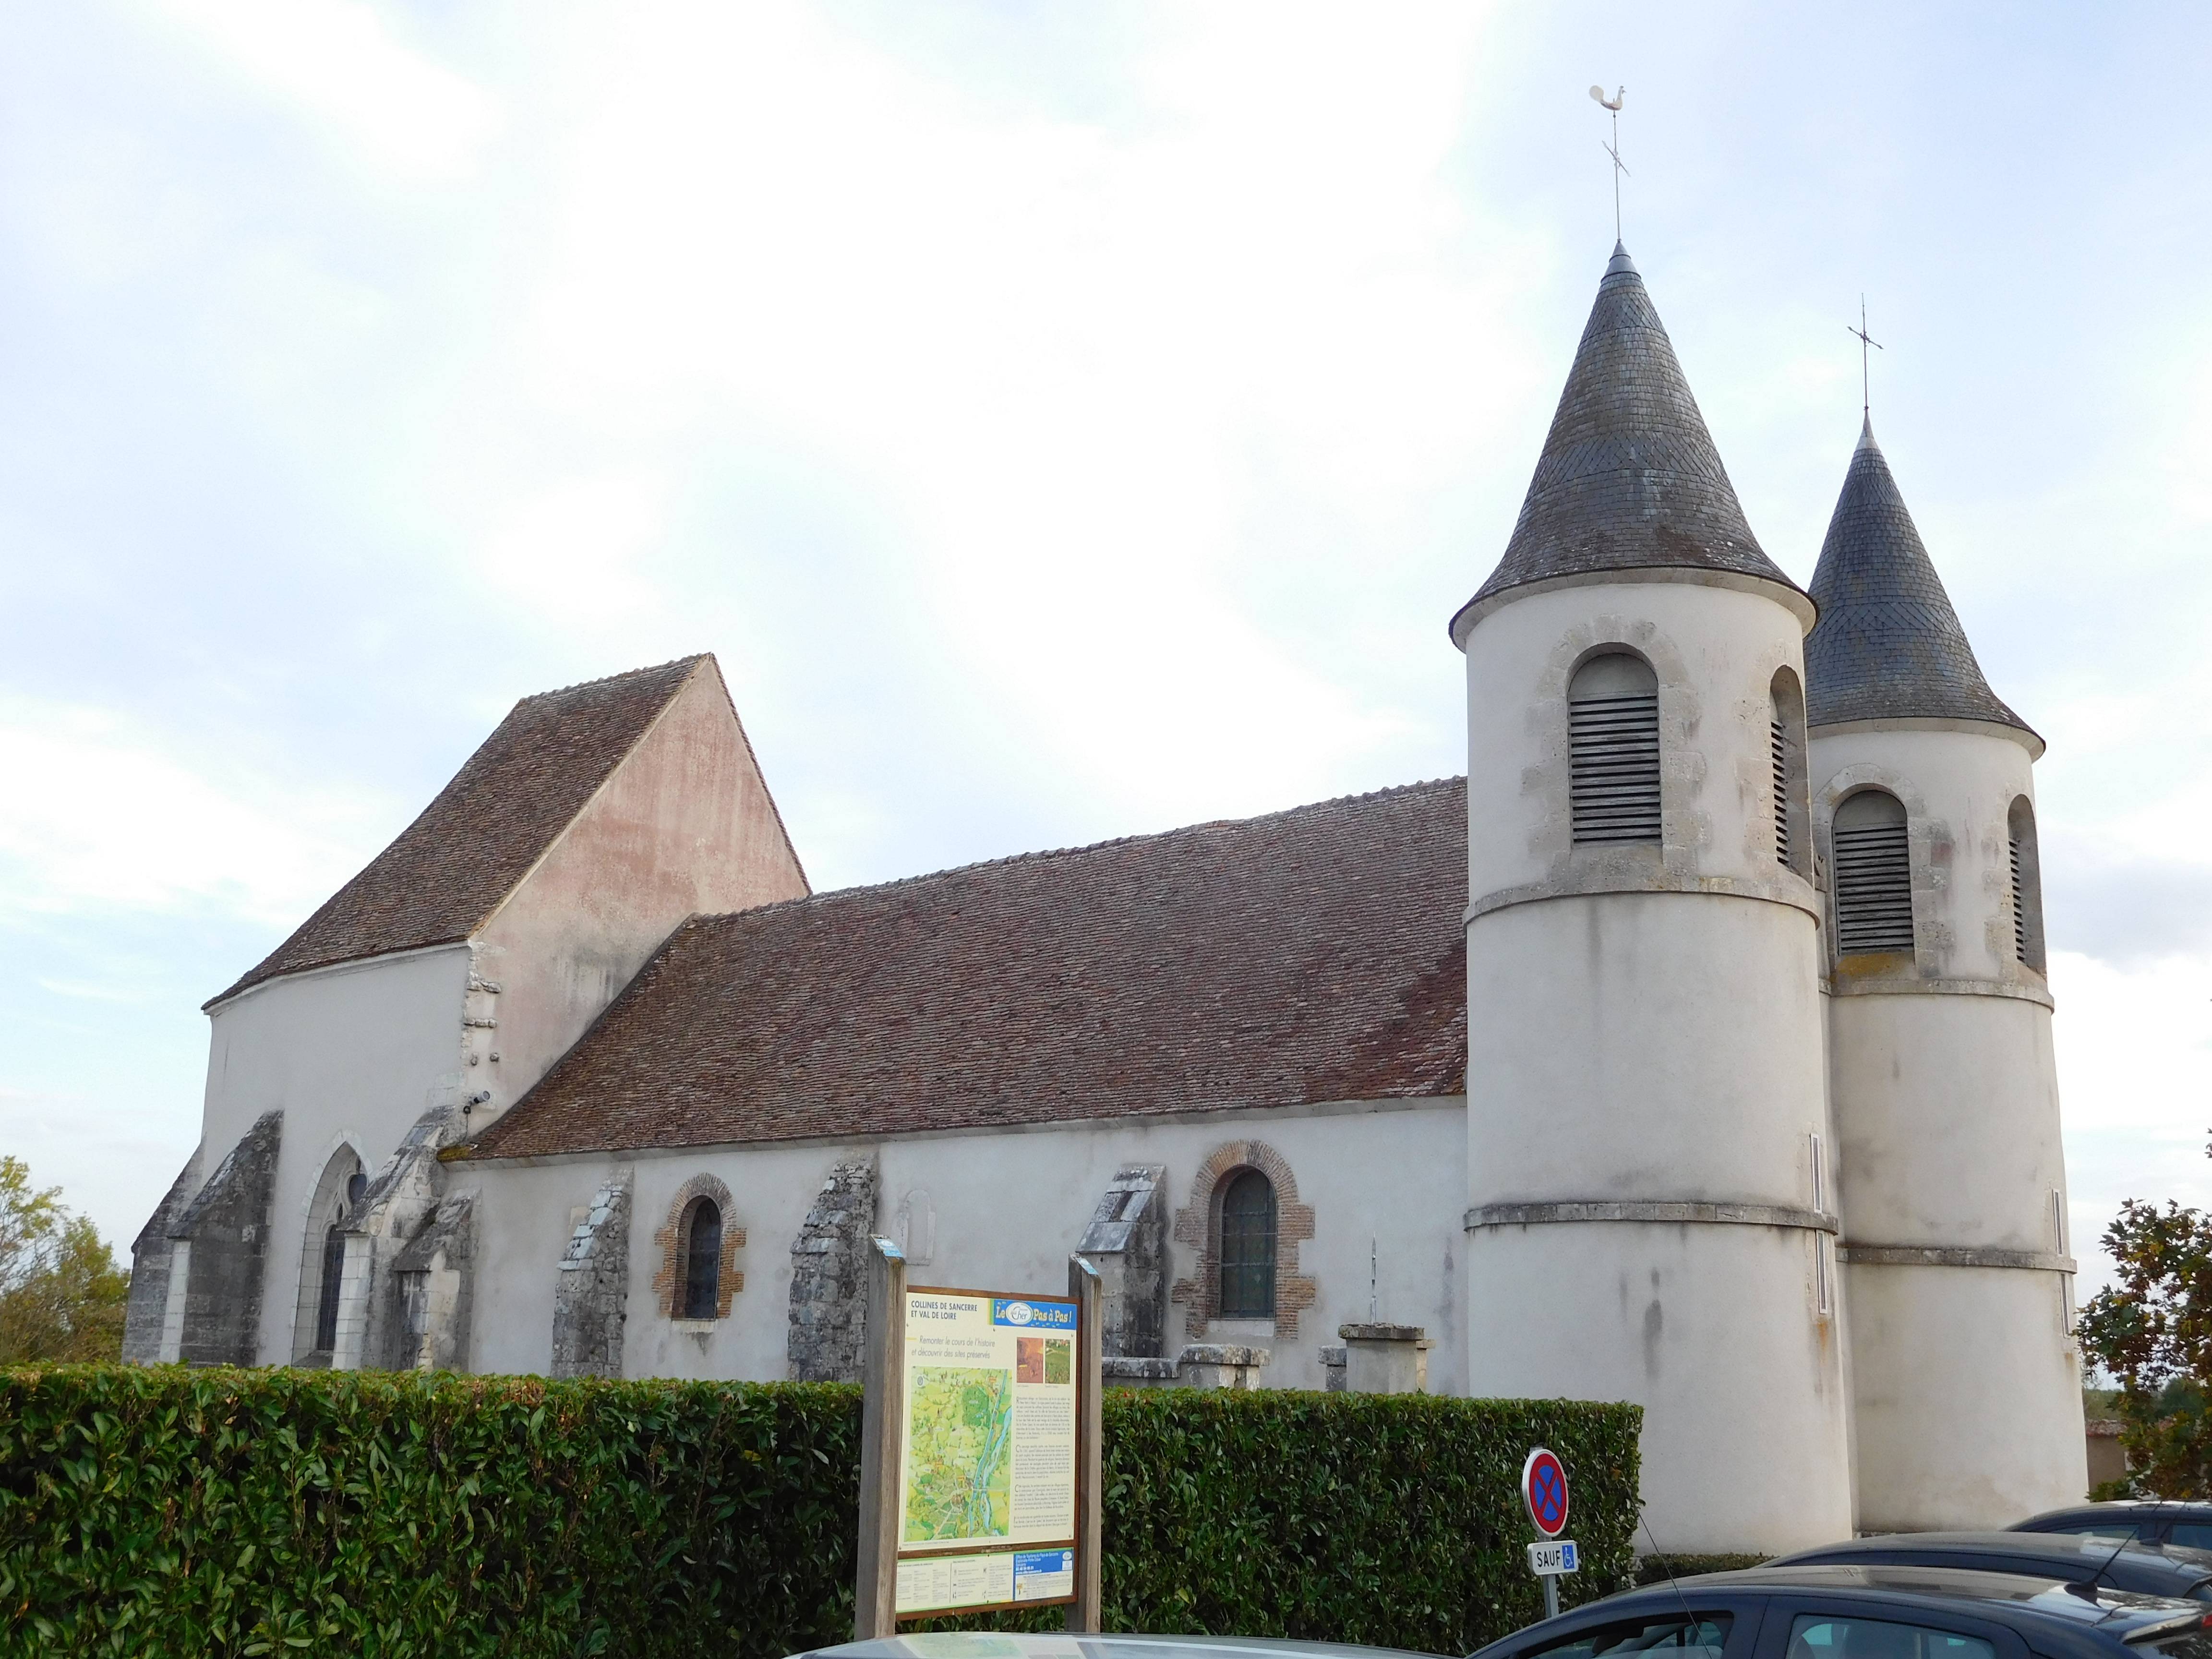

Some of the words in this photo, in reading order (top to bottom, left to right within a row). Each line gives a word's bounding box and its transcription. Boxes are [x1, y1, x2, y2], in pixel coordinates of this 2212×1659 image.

[911, 1300, 938, 1310] COLLINES
[949, 1303, 977, 1311] SANCERRE
[996, 1306, 1005, 1318] Le
[1011, 1306, 1028, 1320] Cher
[1033, 1309, 1047, 1321] Pas
[1048, 1308, 1053, 1322] à
[919, 1335, 944, 1345] Remonter
[945, 1336, 950, 1345] le
[966, 1337, 973, 1346] de
[974, 1338, 995, 1347] l'histoire
[918, 1347, 942, 1357] découvrir
[944, 1348, 953, 1357] des
[966, 1350, 990, 1360] préservés
[1537, 1550, 1560, 1567] SAUF
